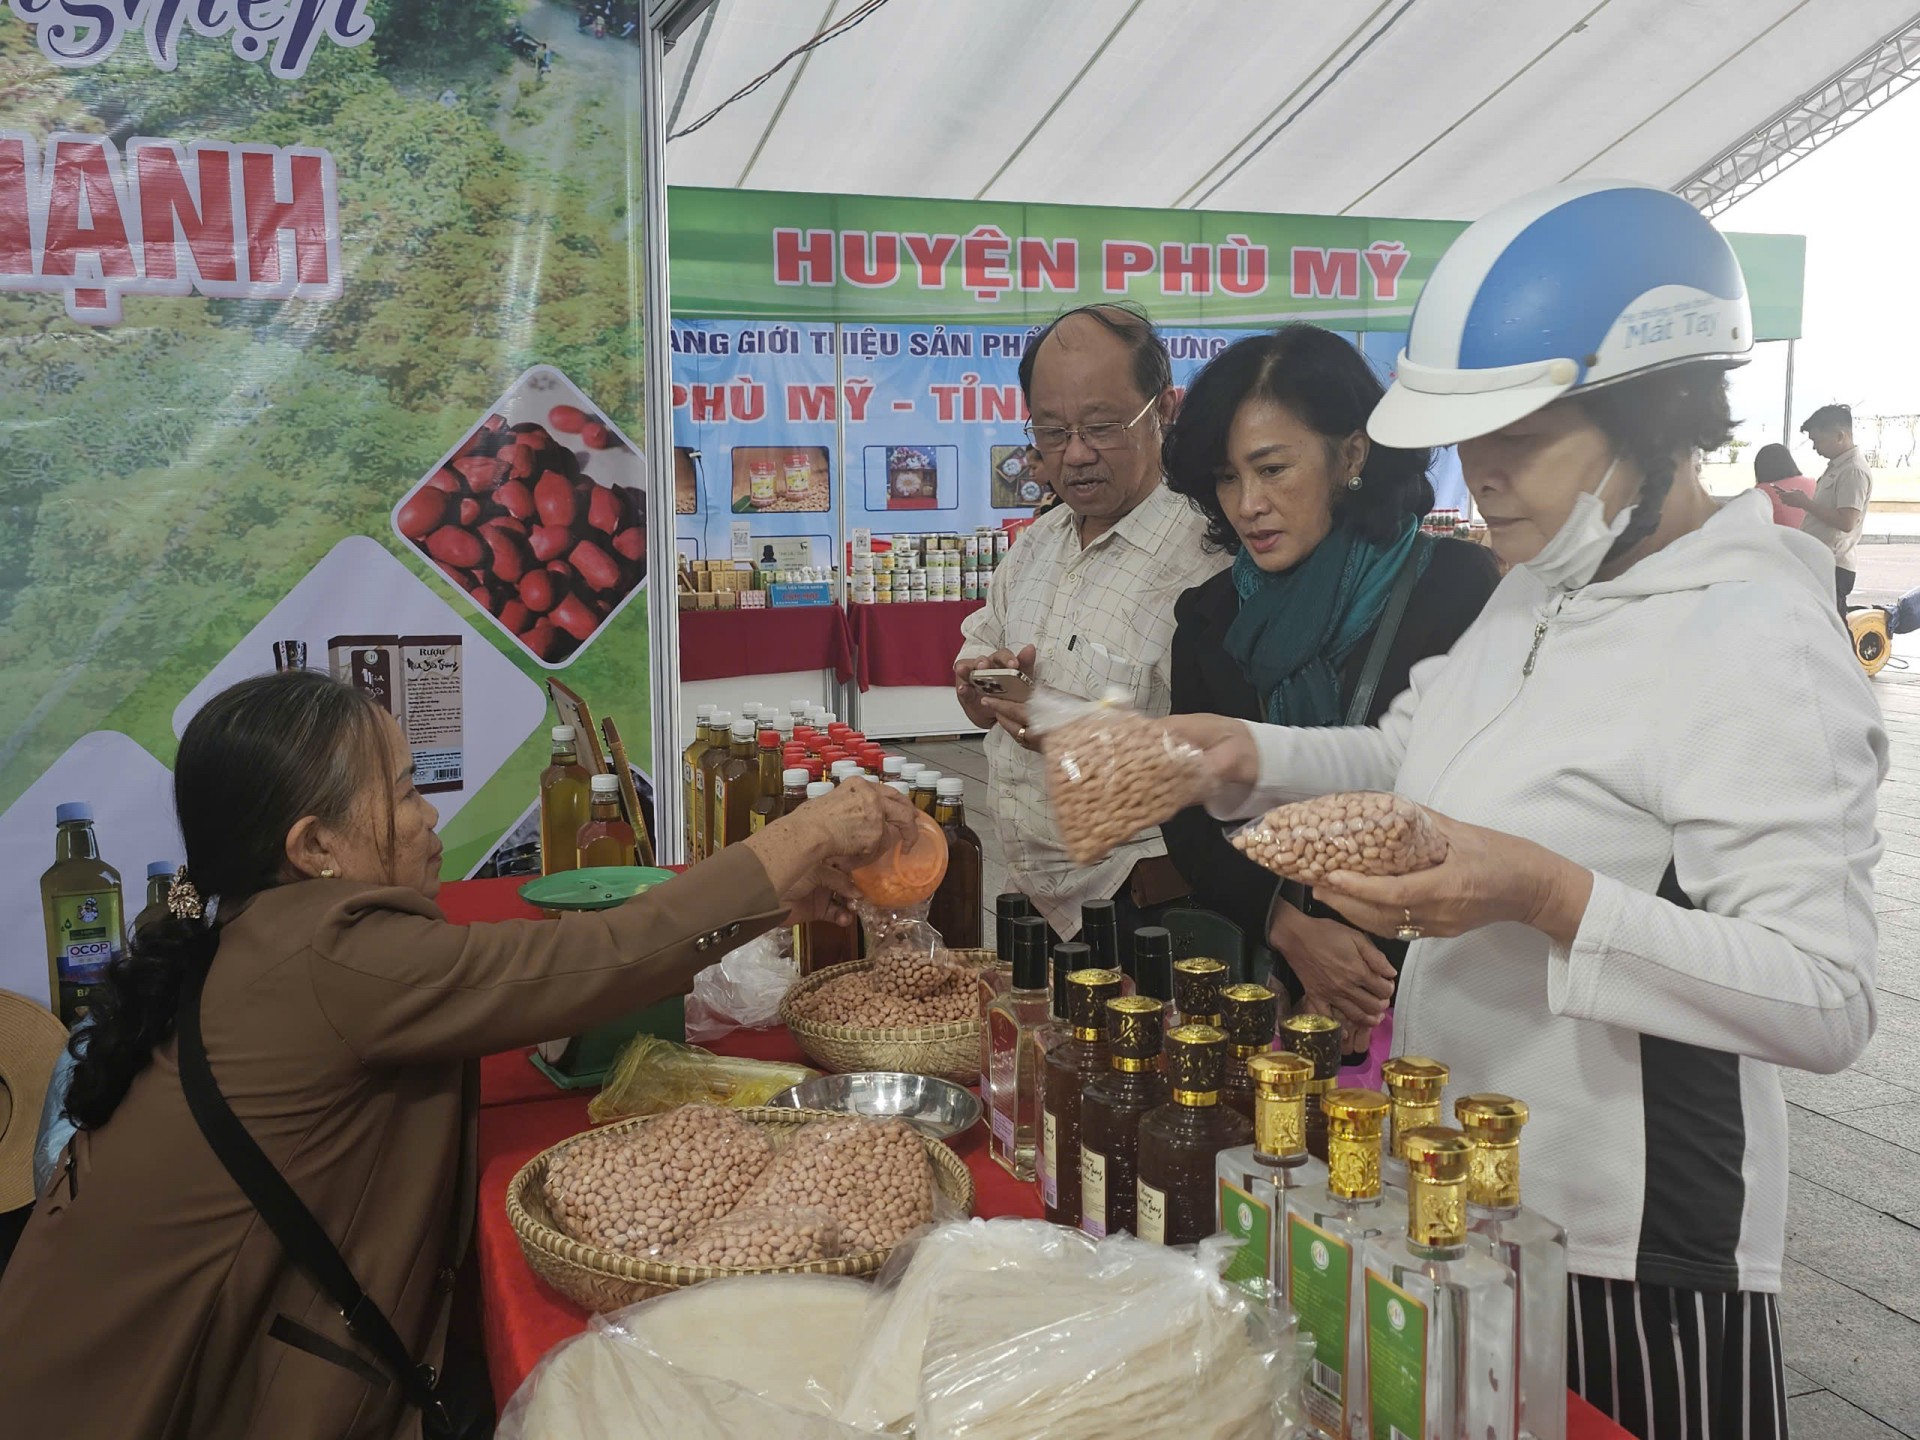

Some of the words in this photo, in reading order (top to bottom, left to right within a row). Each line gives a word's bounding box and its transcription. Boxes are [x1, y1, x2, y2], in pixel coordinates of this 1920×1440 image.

[774, 226, 1076, 301] HUYỆN
[1103, 235, 1267, 295] PHÙ
[1292, 242, 1409, 299] MỸ
[671, 327, 729, 354] ÀNG
[738, 325, 799, 354] GIỚI
[811, 328, 899, 360] THIỆU
[910, 326, 971, 357] SẢN
[1161, 335, 1227, 359] ƯNG
[673, 375, 764, 421] PHÙ
[787, 378, 874, 422] MỸ
[70, 943, 108, 956] OCOP
